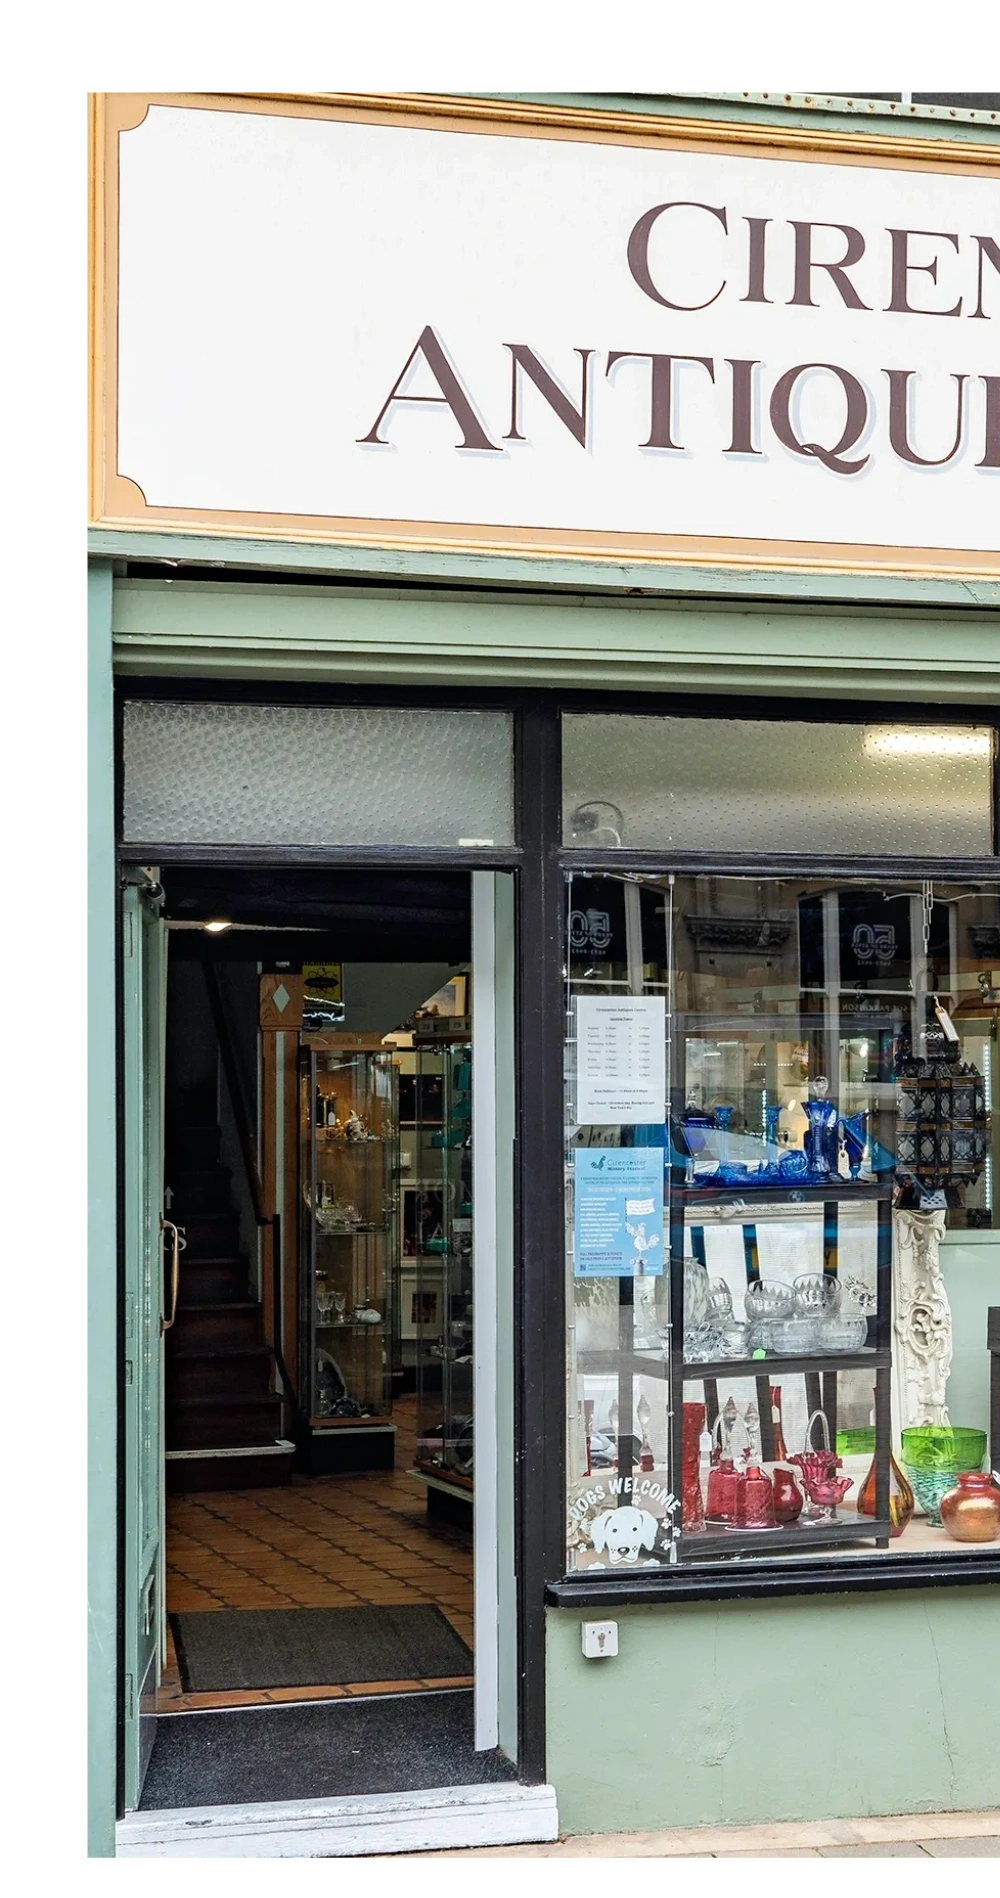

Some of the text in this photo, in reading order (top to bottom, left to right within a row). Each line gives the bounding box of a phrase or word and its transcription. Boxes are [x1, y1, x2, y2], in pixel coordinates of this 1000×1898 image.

[607, 1159, 646, 1167] Cirencester
[568, 1476, 682, 1520] DOGS WELCOME
